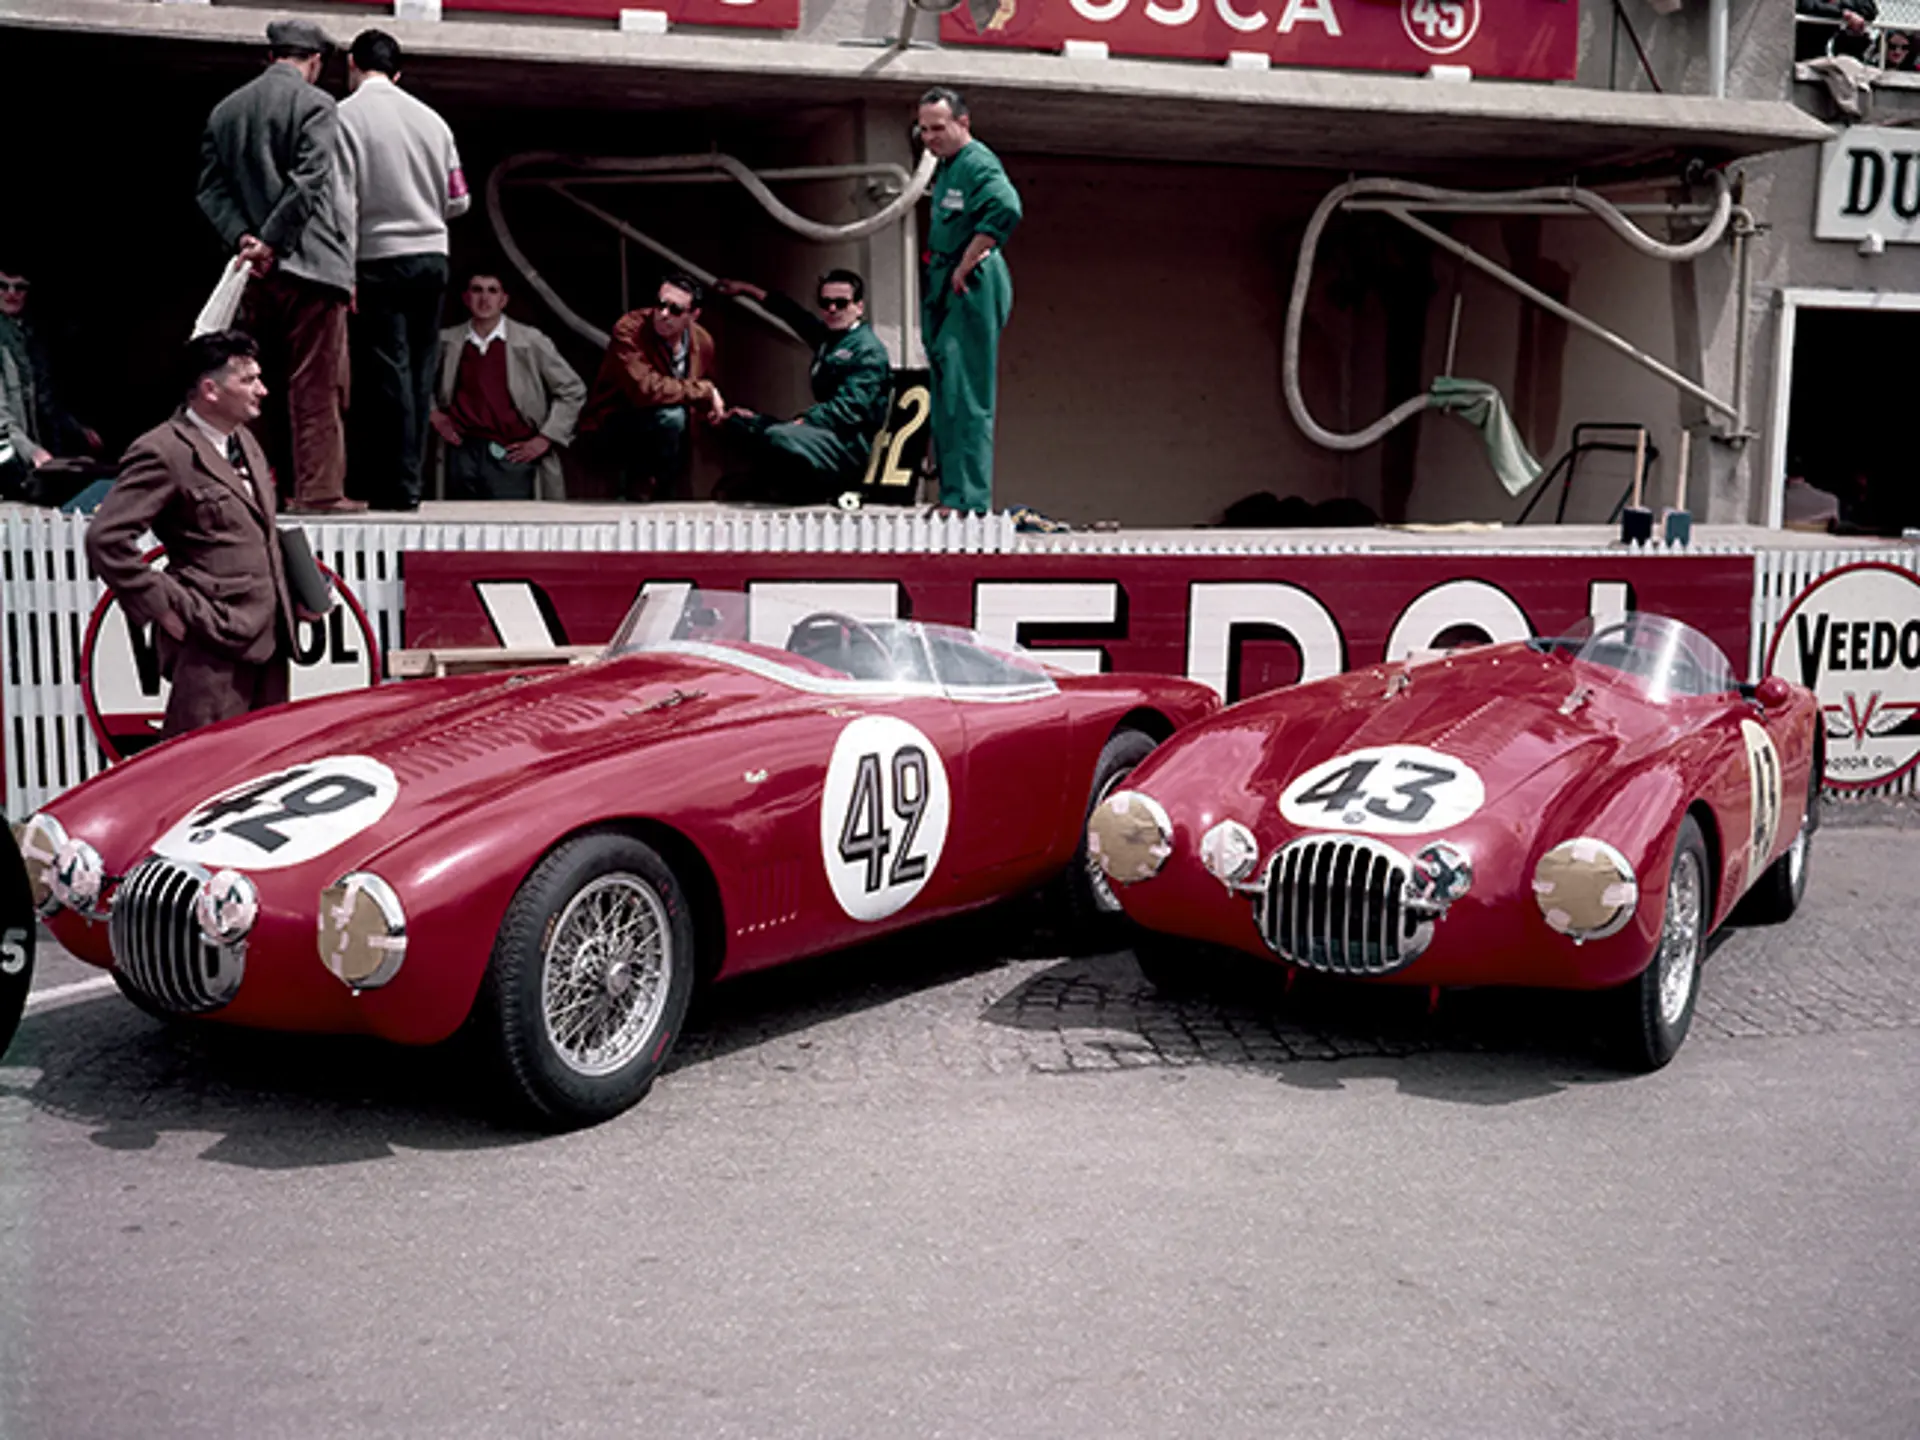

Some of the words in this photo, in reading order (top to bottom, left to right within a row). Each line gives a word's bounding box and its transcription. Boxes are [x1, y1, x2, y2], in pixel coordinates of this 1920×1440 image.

[1842, 148, 1920, 220] DU
[1797, 613, 1920, 693] VEEDO
[1294, 759, 1457, 823] 43
[1824, 755, 1869, 771] OTOR
[838, 744, 930, 893] 42
[0, 928, 28, 974] 5
